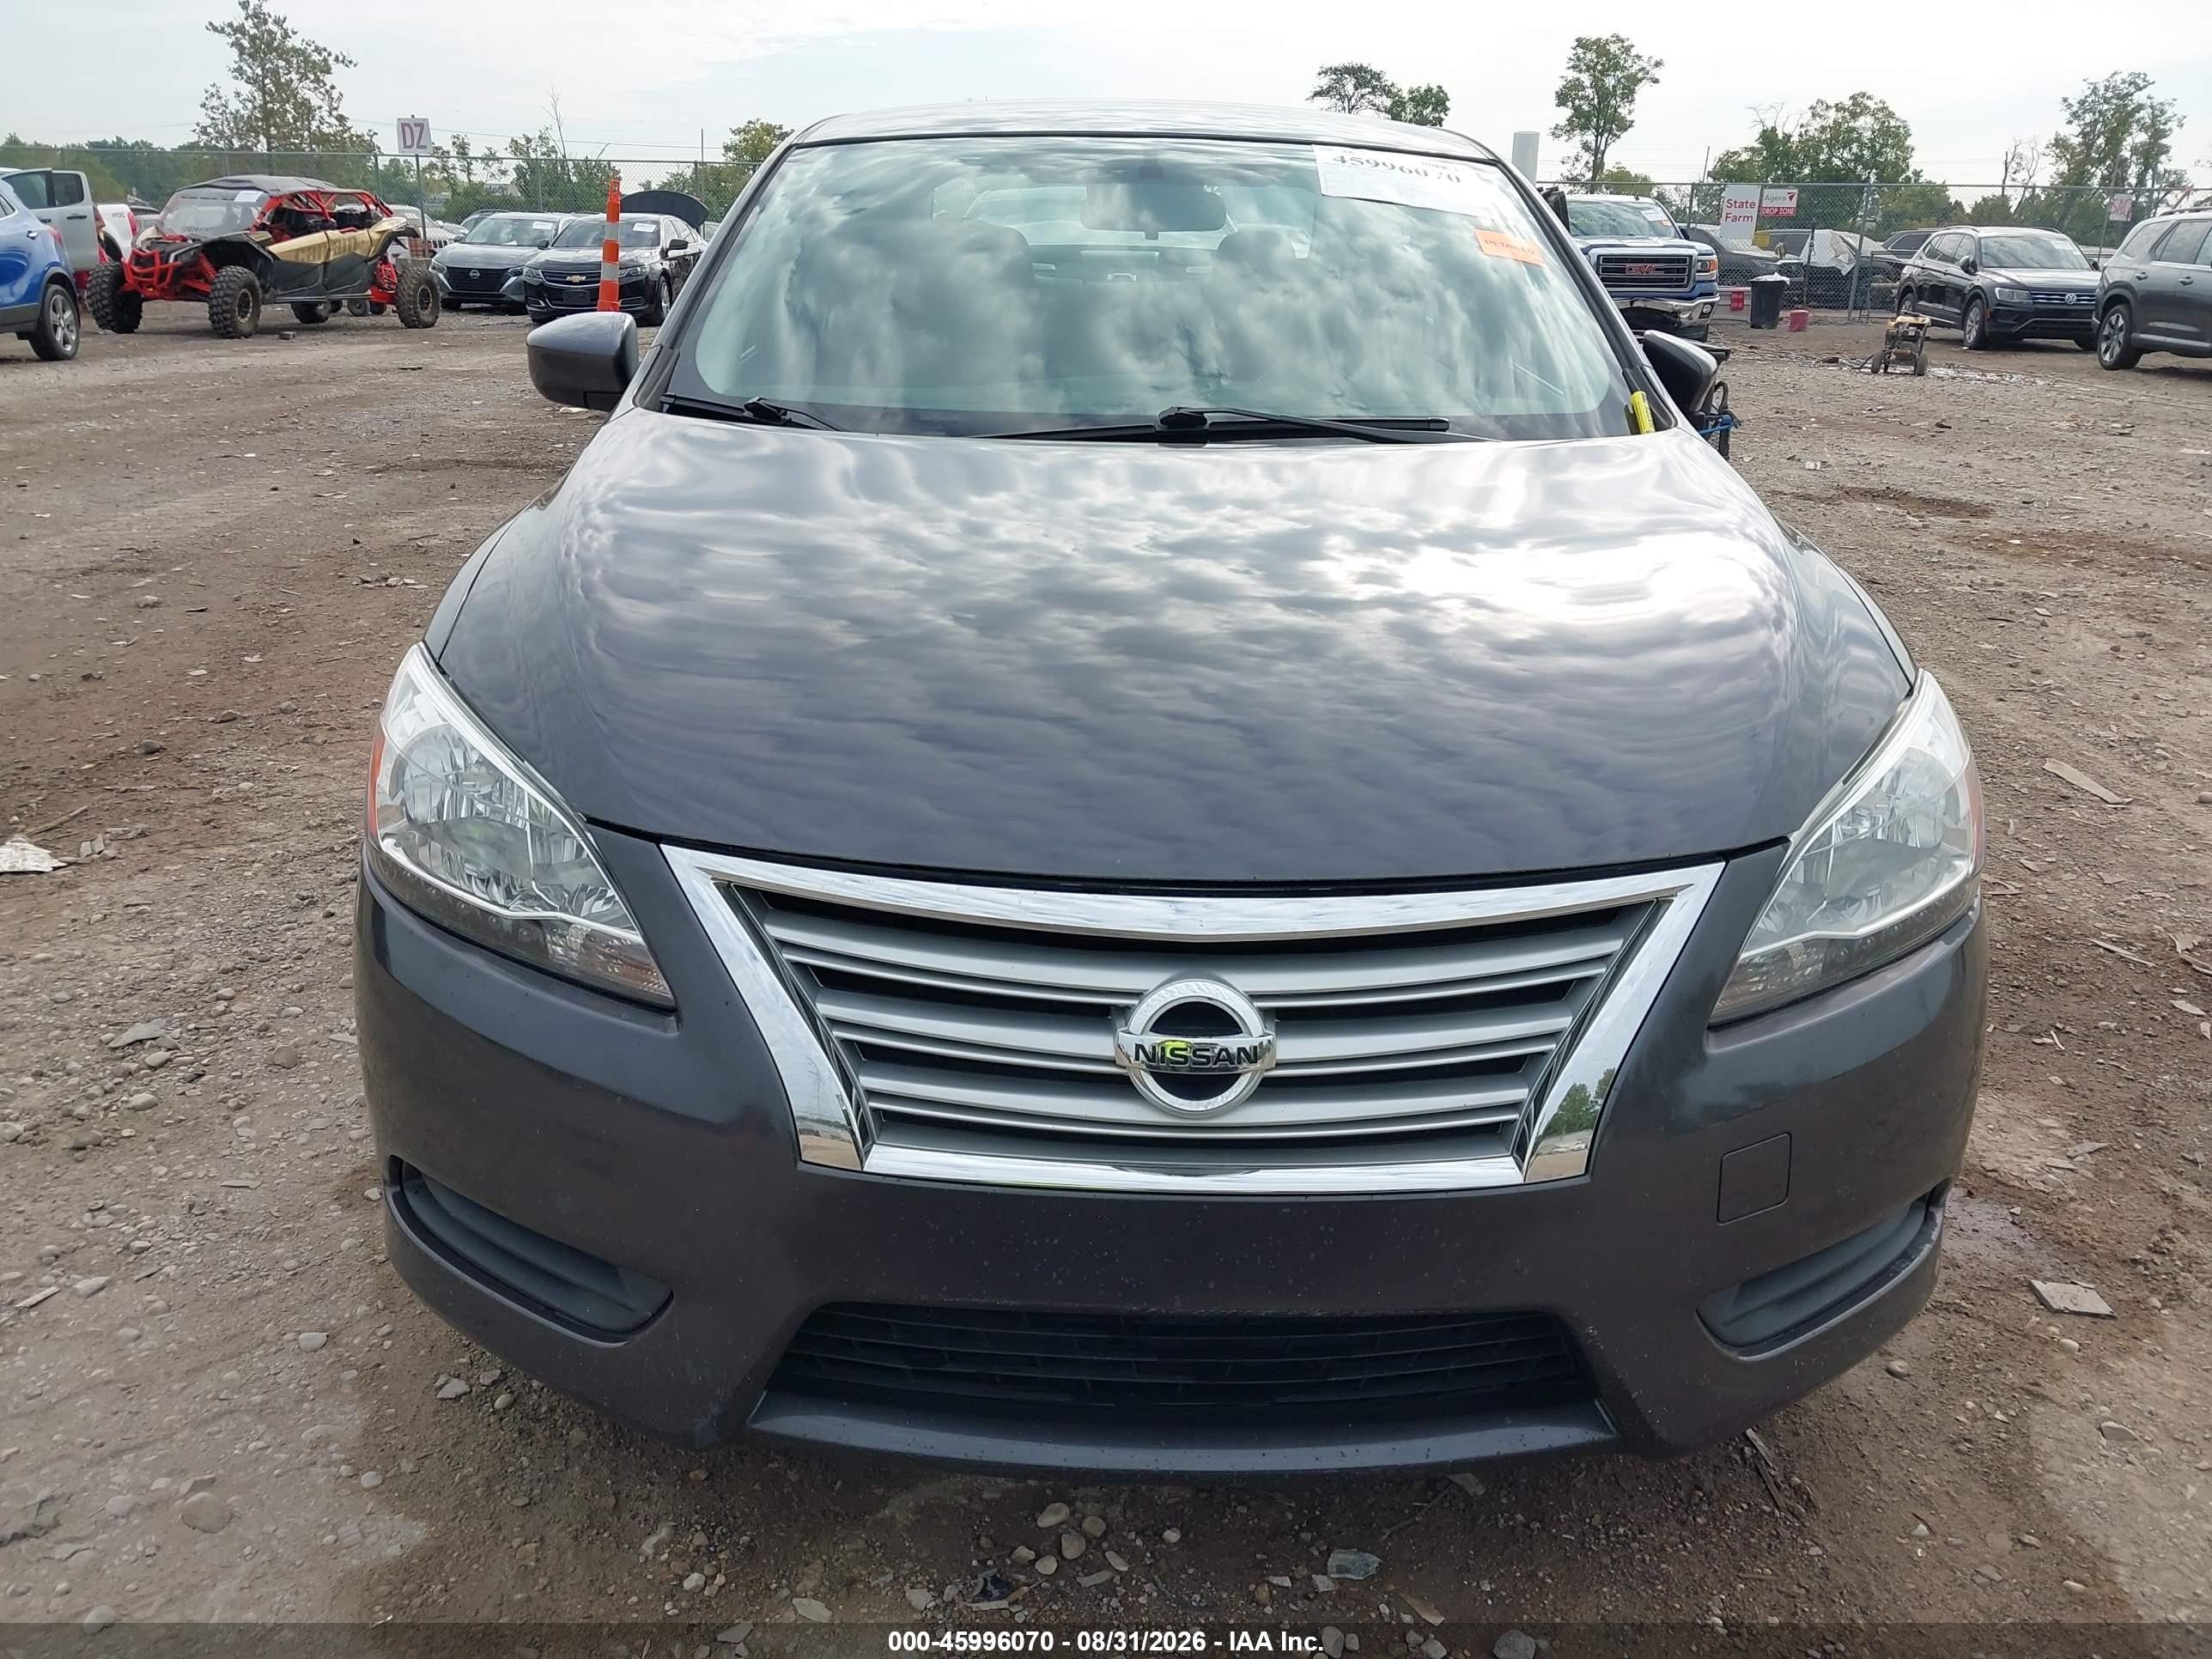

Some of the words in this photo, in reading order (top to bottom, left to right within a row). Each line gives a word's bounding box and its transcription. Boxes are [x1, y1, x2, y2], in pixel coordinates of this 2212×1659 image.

[401, 123, 427, 149] DZ
[1726, 198, 1756, 209] State
[1725, 213, 1753, 222] Farm
[1626, 264, 1664, 275] GMC
[1134, 1042, 1258, 1066] NISSAN
